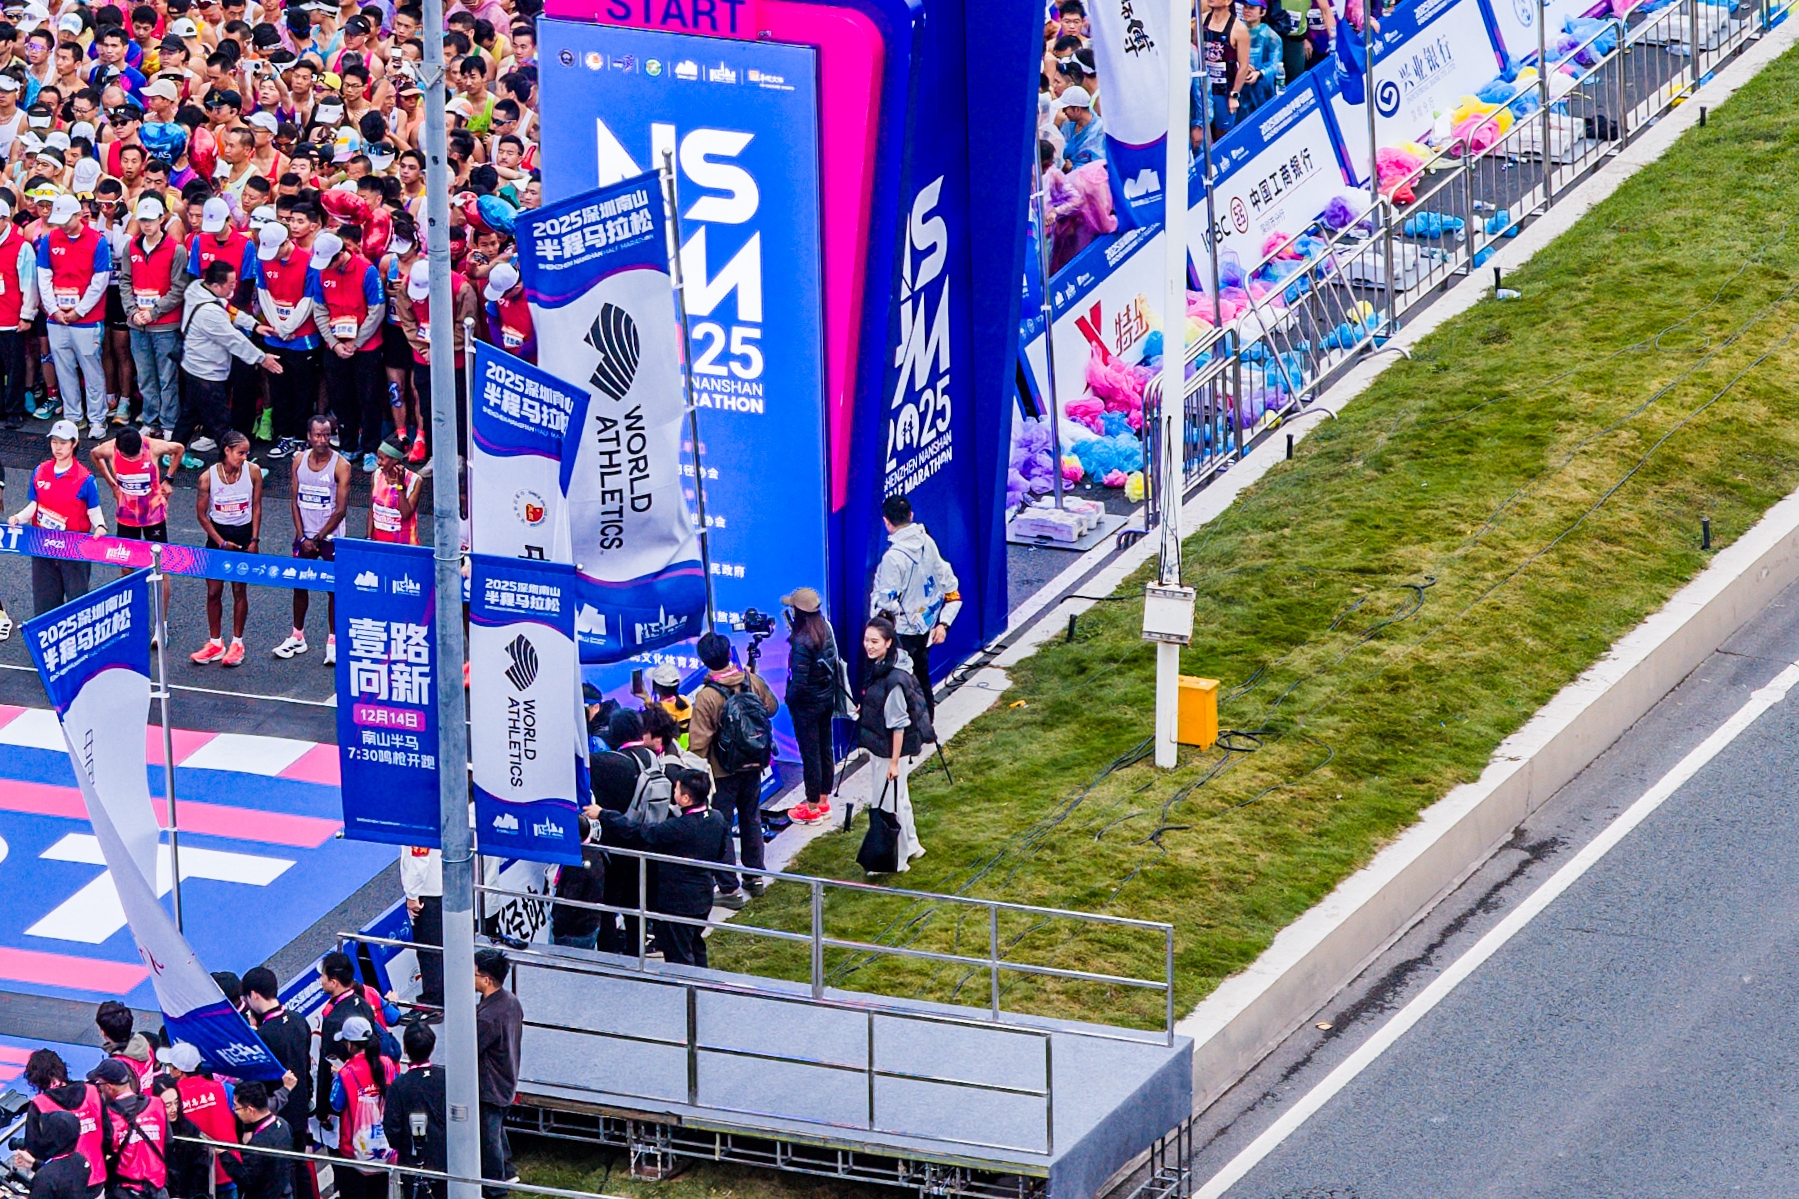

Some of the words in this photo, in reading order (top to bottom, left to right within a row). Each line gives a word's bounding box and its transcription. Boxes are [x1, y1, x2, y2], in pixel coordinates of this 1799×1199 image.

[1397, 34, 1454, 90] 兴业银行
[1249, 147, 1313, 210] 中国工商银行
[532, 190, 649, 237] 2025深圳南山
[535, 210, 654, 261] 半程马拉松
[691, 322, 763, 379] 25
[624, 404, 653, 513] WORLD
[904, 447, 953, 495] MARATHON
[918, 430, 952, 468] NANSHAN
[596, 416, 624, 551] ATHLETICS
[485, 578, 561, 598] 2025深圳南山
[485, 590, 561, 612] 半程马拉松
[37, 590, 132, 648] 2025深圳南山
[43, 607, 131, 672] 半程马拉松
[348, 617, 429, 664] 壹路
[349, 659, 431, 705] 向新
[360, 708, 418, 729] 12月14日
[361, 730, 419, 751] 南山半马
[507, 696, 523, 787] ATHLETICS
[523, 699, 537, 760] WORLD
[348, 747, 435, 770] 7:30鸣枪开跑
